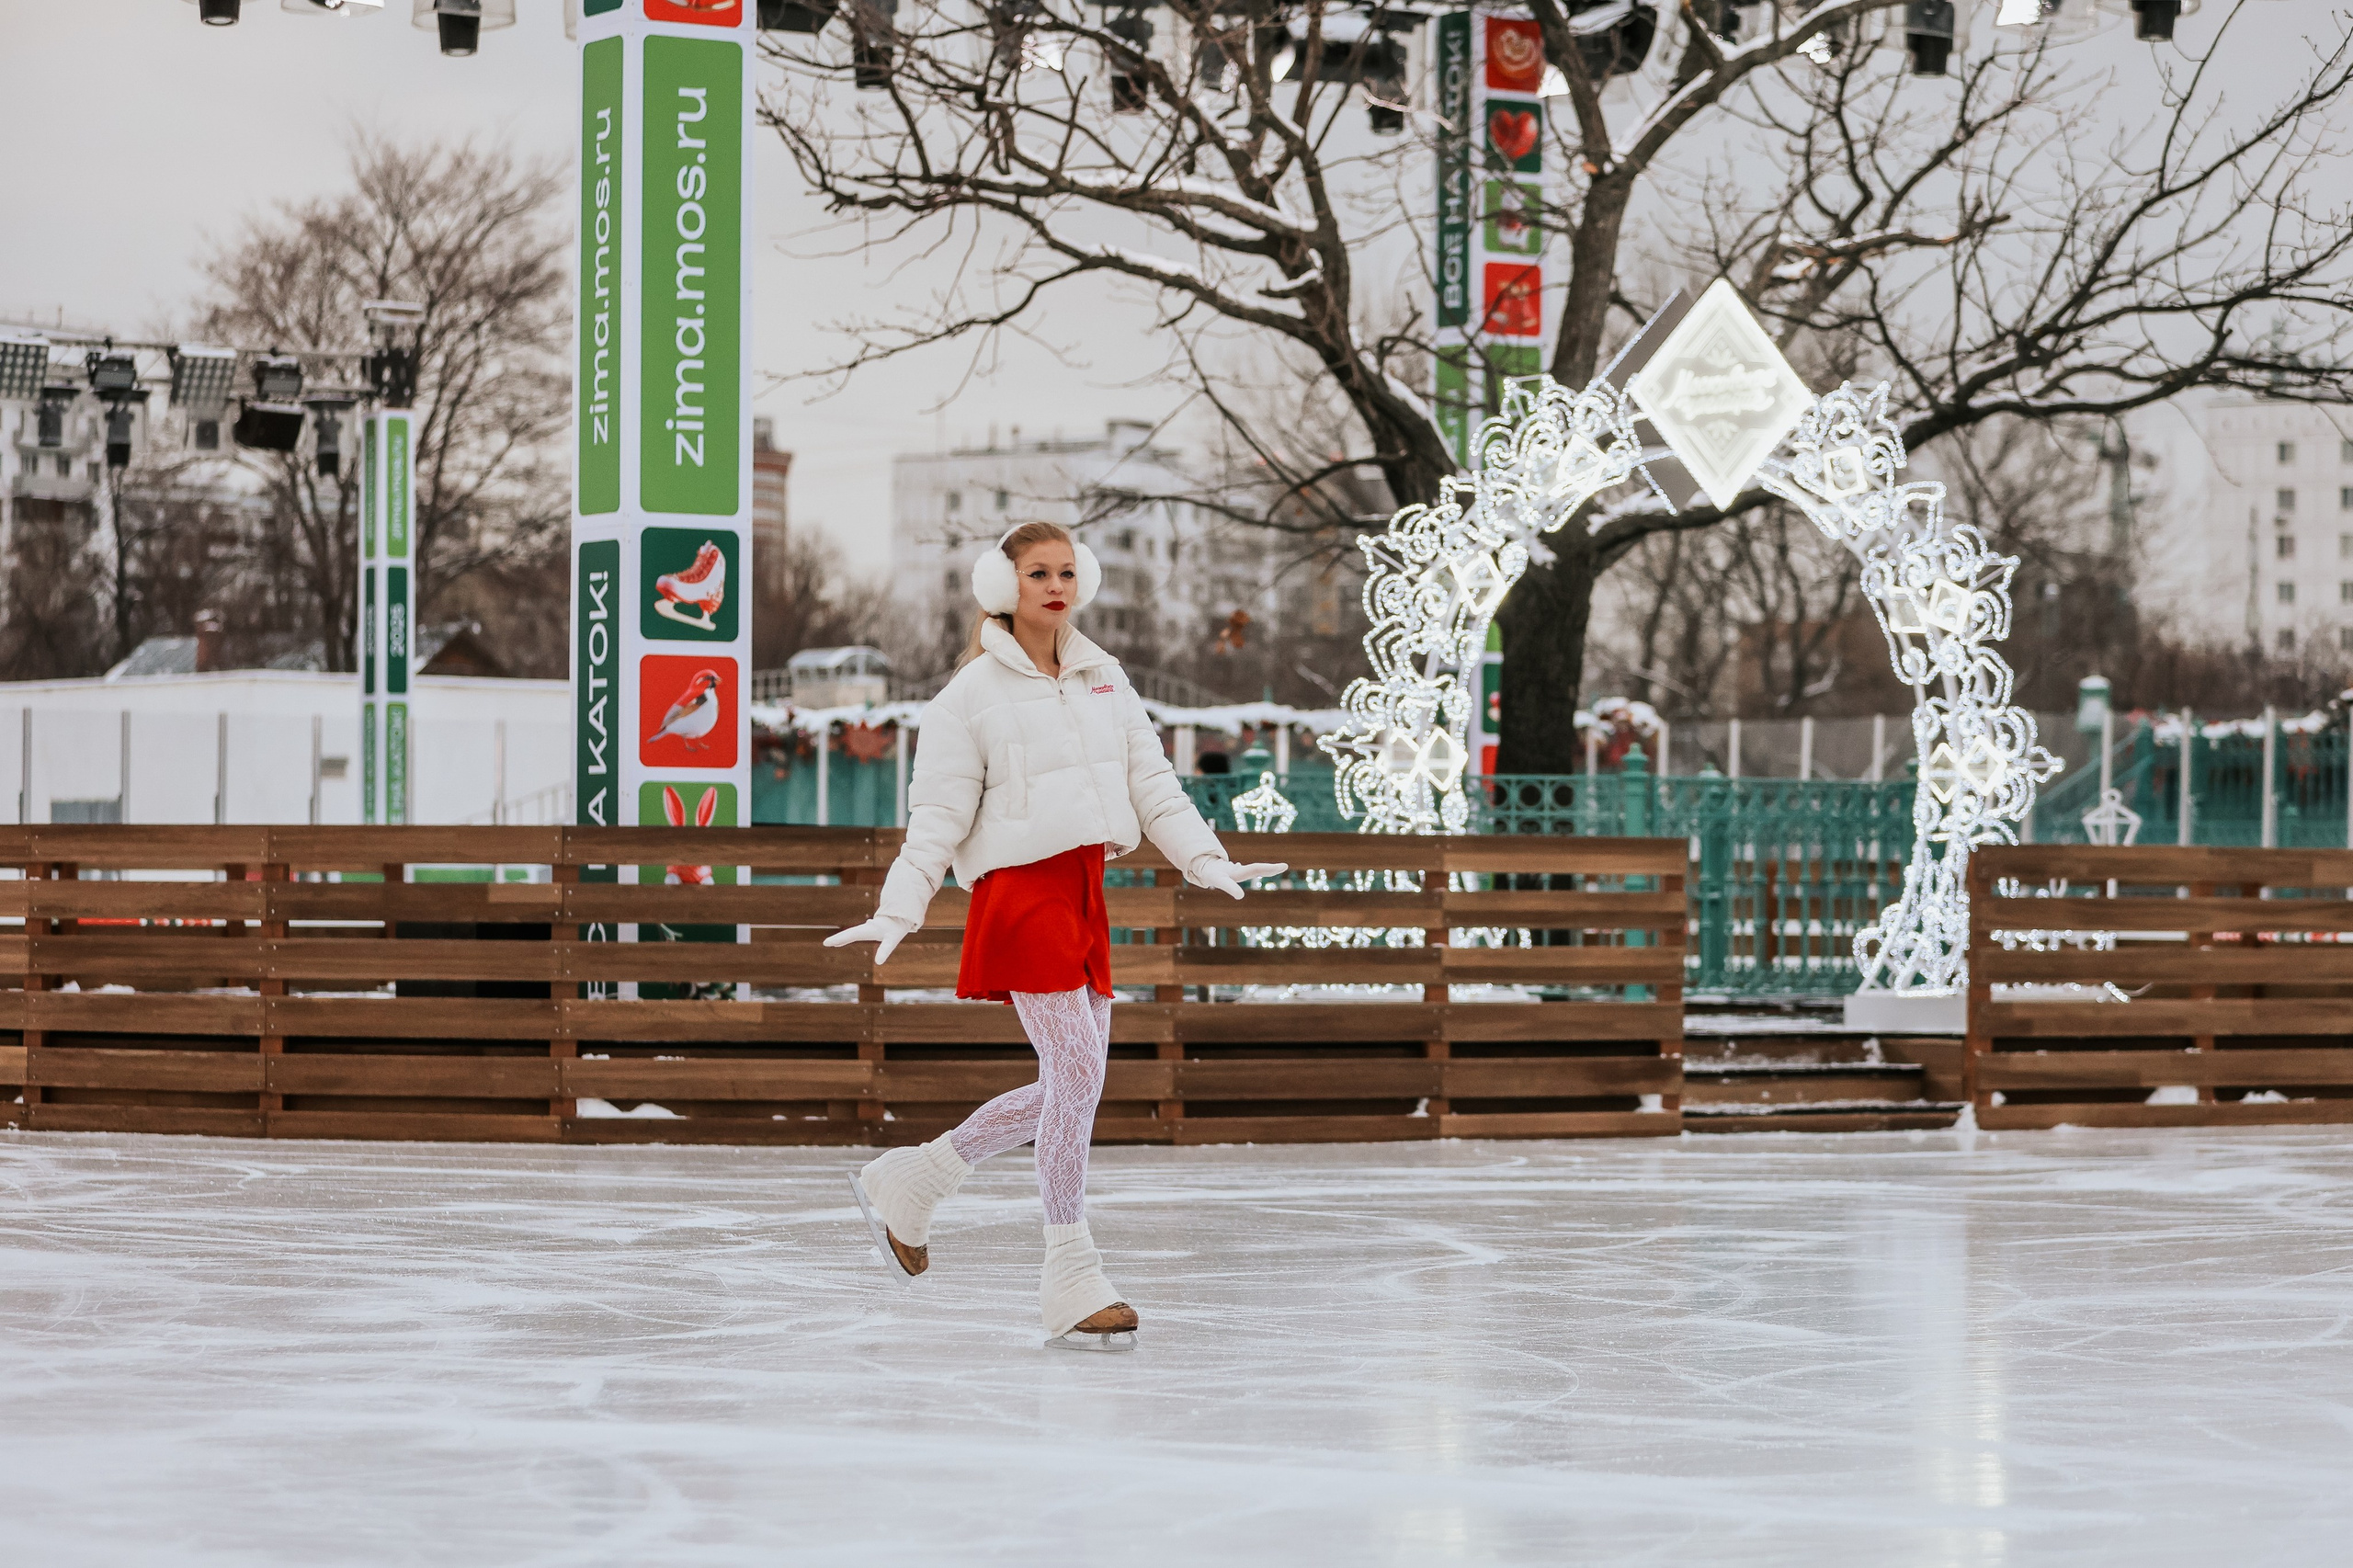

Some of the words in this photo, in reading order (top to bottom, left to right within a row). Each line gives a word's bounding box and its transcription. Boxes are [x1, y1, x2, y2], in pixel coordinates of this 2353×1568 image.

[589, 106, 613, 446] zima.mos.ru
[665, 86, 708, 468] zima.mos.ru
[587, 570, 608, 776] КАТОК!
